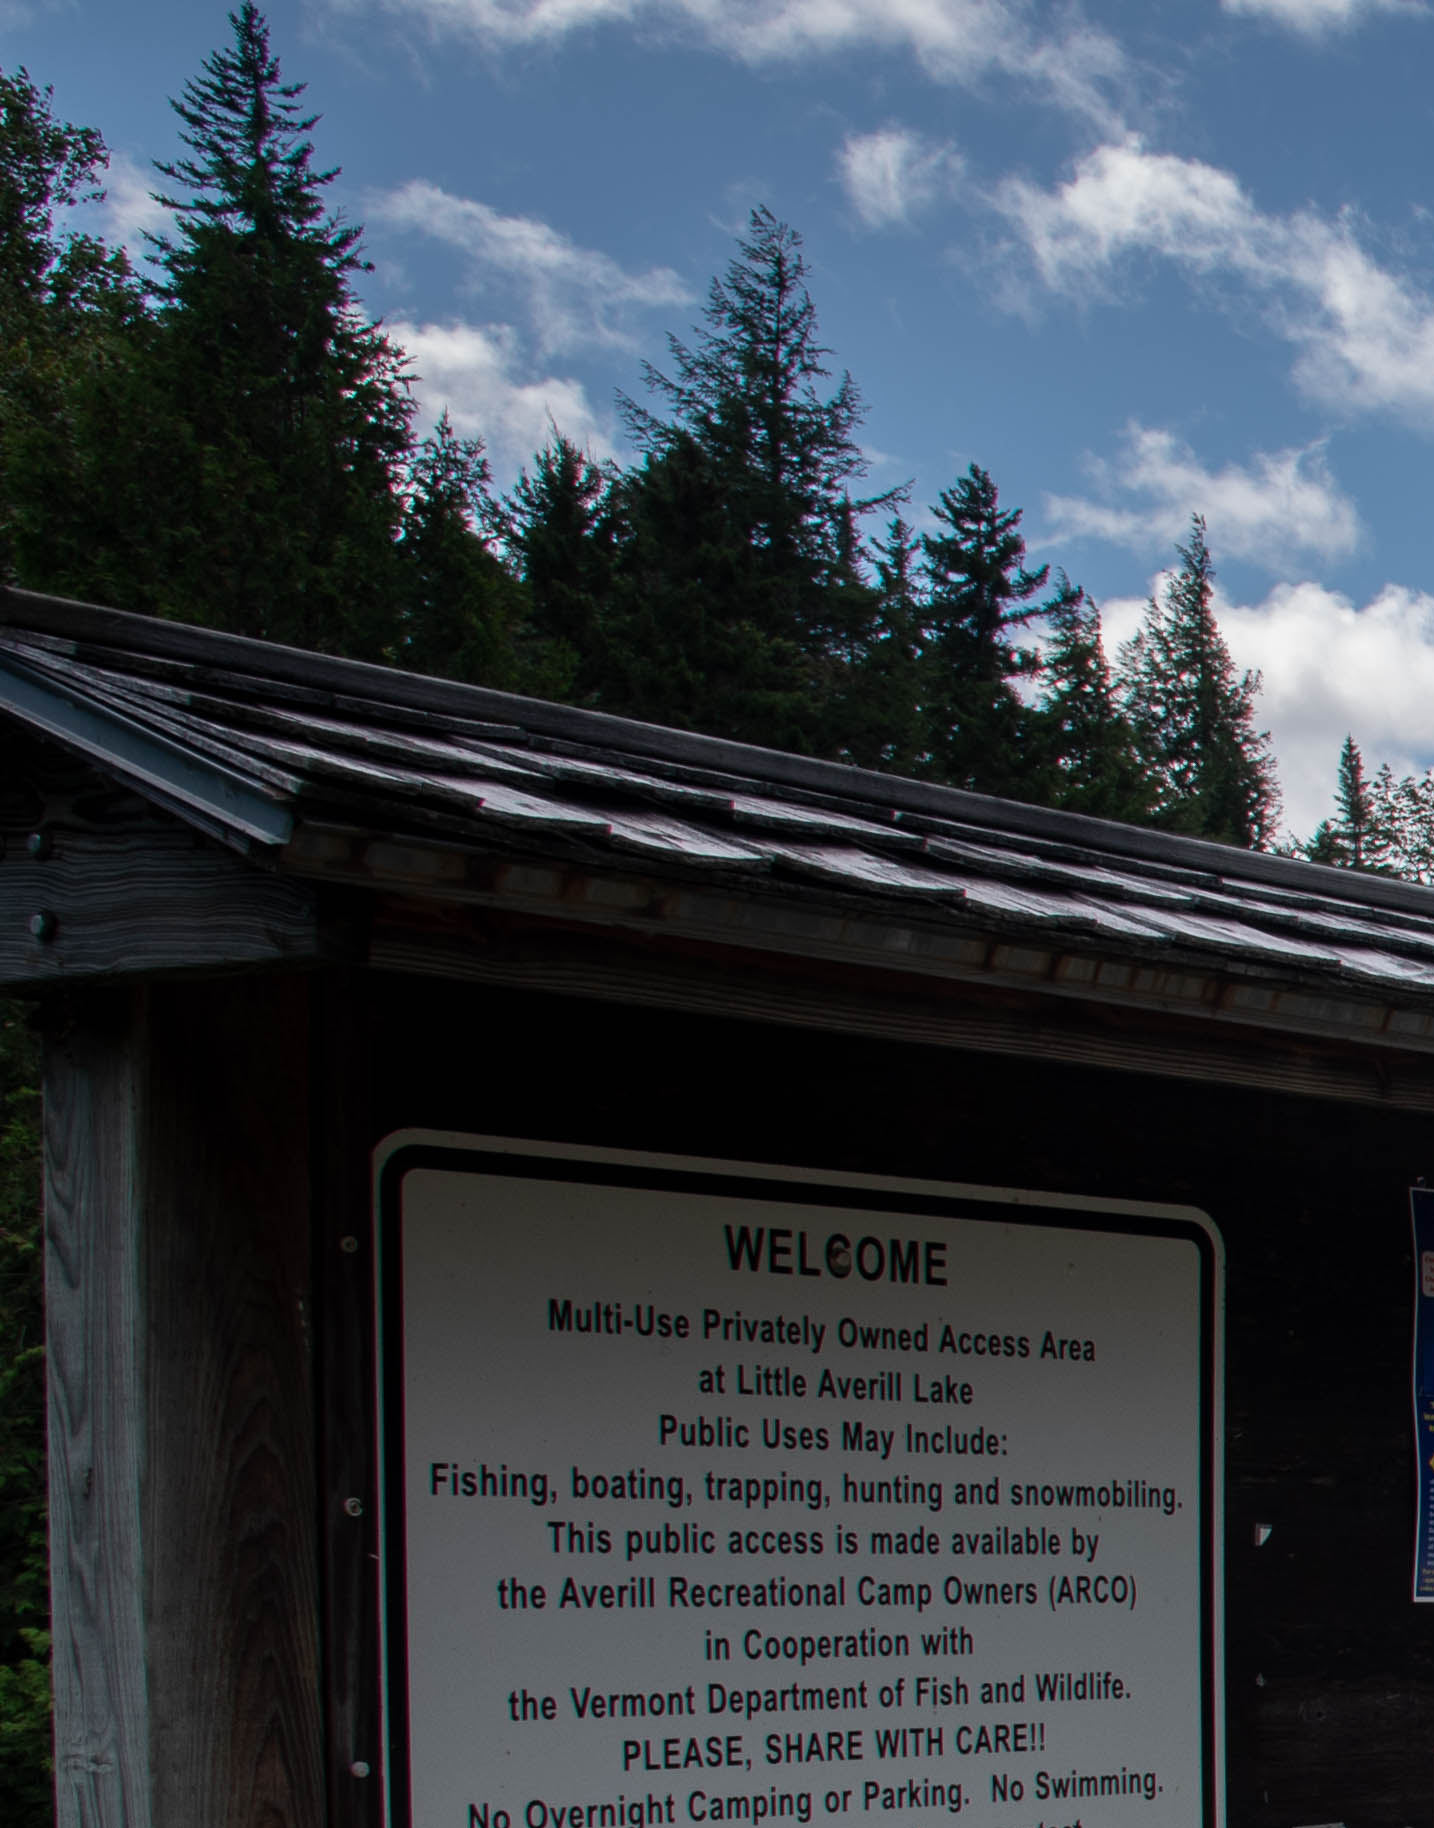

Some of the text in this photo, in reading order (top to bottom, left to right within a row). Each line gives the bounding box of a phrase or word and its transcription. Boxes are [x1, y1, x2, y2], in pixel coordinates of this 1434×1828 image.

[723, 1224, 948, 1287] WELCOME
[548, 1298, 1096, 1362] Multi-Use Privately Owned Access Area
[698, 1364, 974, 1405] at Little Averill Lake
[659, 1413, 1008, 1461] Public Uses May Include:
[431, 1462, 1183, 1516] Fishing, boating, trapping, hunting and snowmobiling.
[547, 1520, 1099, 1563] This public access is made available by
[497, 1575, 1137, 1613] the Averill Recreational Camp Owners (ARCO)
[705, 1625, 974, 1667] in Cooperation with
[507, 1671, 1131, 1722] the Vermont Department of Fish and Wildlife.
[623, 1722, 1045, 1772] PLEASE, SHARE WITH CARE!!
[687, 1786, 812, 1826] Camping
[824, 1789, 853, 1814] or
[863, 1777, 970, 1814] Parking.
[991, 1773, 1024, 1803] No
[1035, 1766, 1163, 1801] Swimming.
